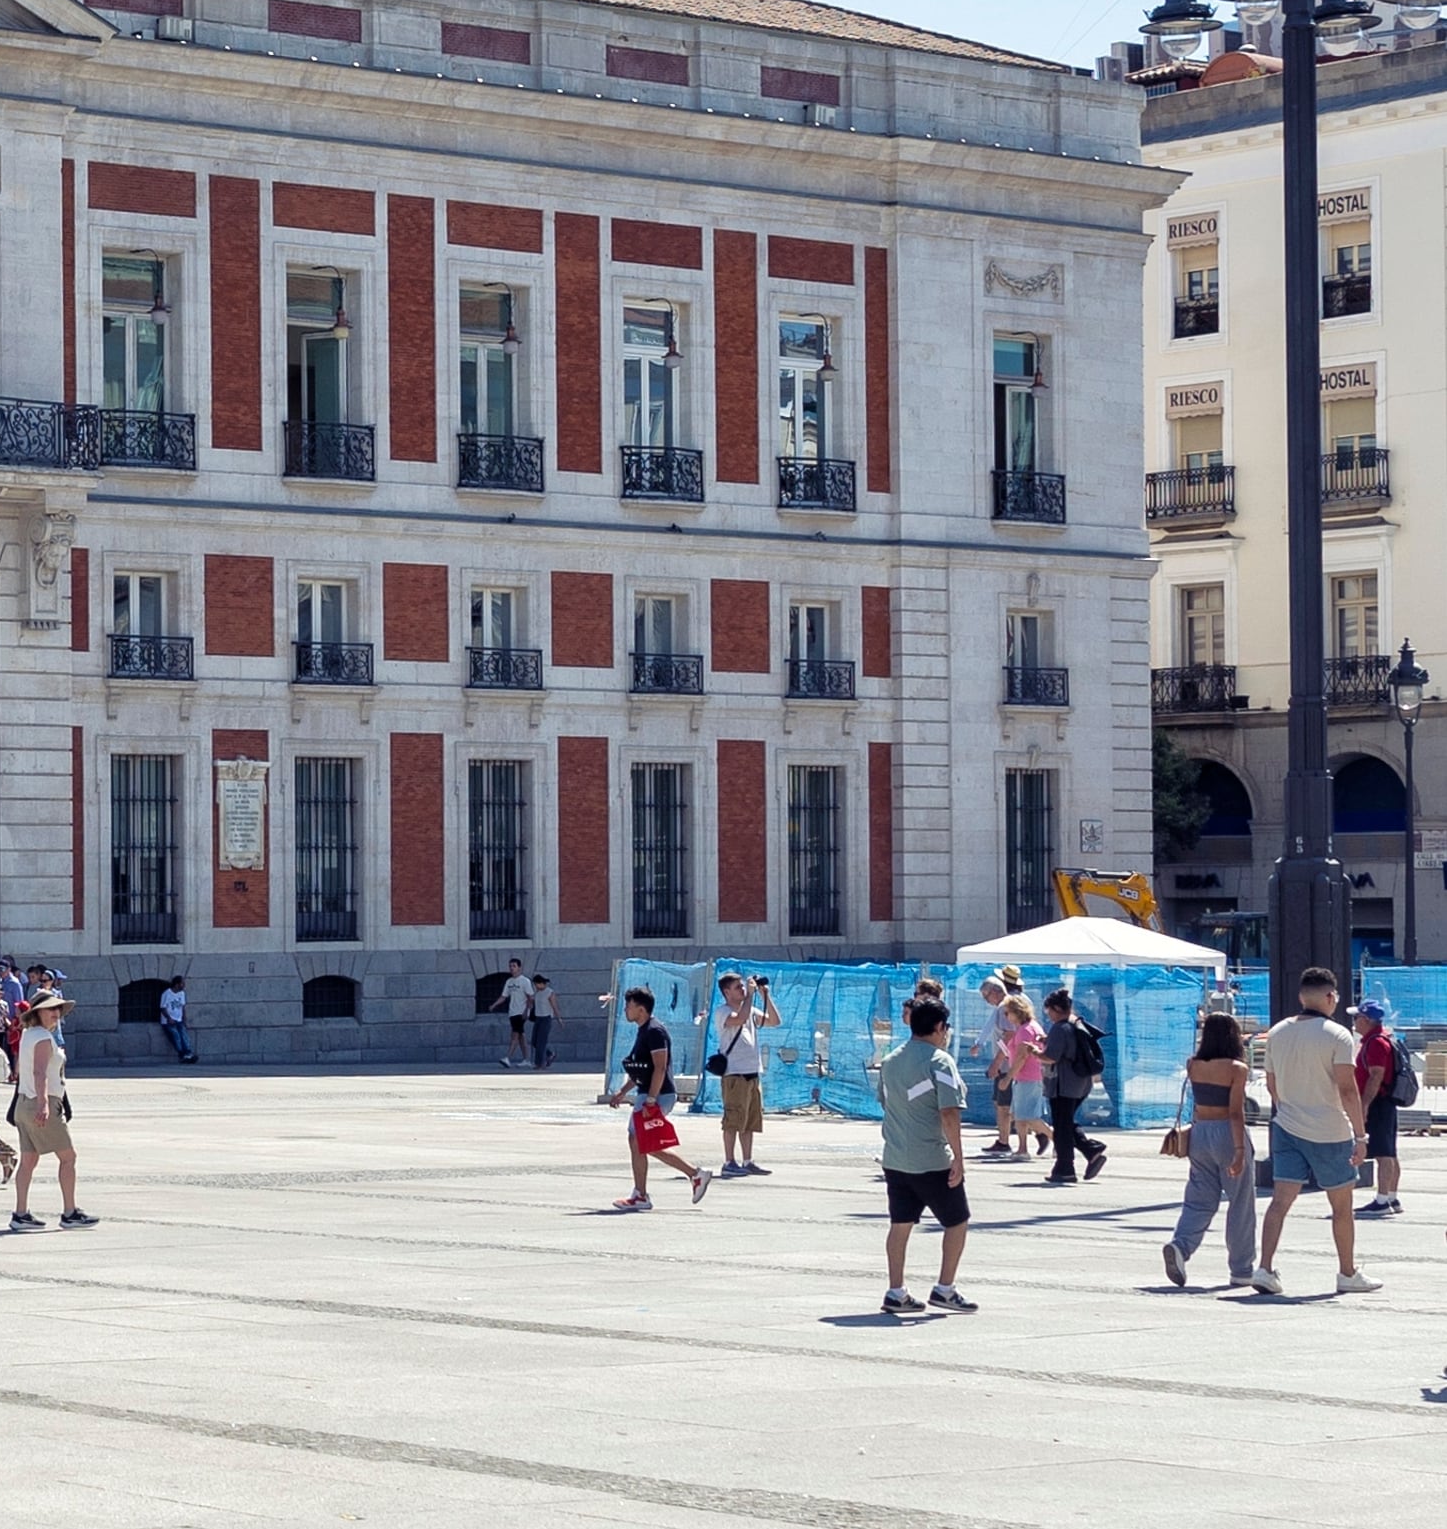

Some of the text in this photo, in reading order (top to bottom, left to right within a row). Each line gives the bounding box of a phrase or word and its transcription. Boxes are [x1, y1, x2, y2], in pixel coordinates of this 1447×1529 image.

[1318, 193, 1368, 217] HOSTAL
[1169, 218, 1217, 239] RIESCO
[1321, 369, 1370, 390] HOSTAL
[1170, 388, 1218, 407] RIESCO
[1119, 888, 1138, 899] JCB
